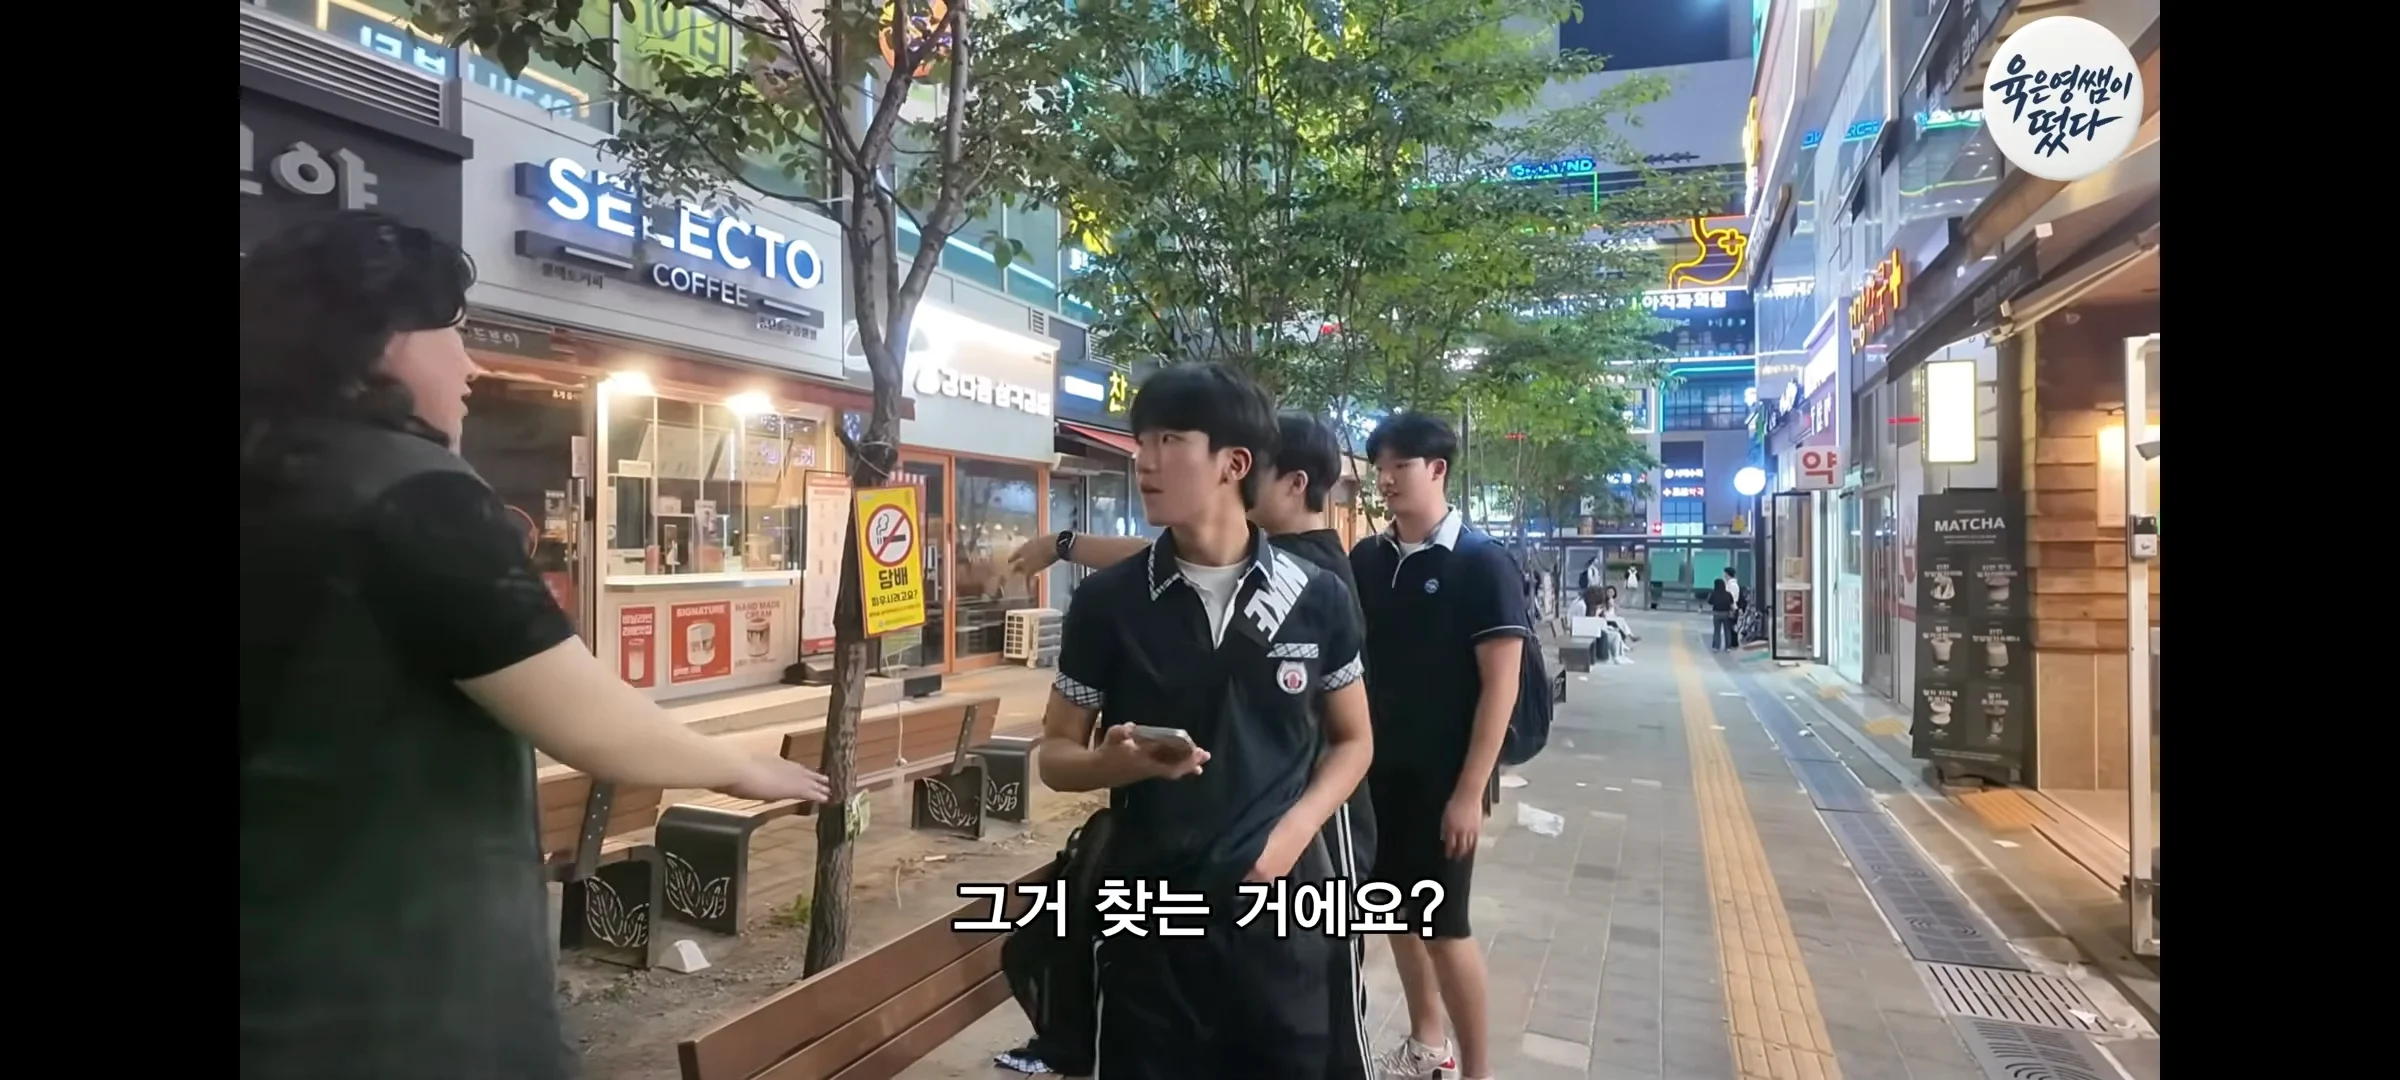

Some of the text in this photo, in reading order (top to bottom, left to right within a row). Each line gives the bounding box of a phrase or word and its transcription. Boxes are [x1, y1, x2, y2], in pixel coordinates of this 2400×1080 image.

[652, 262, 749, 308] COFFEE
[1801, 450, 1838, 485] 약
[1933, 516, 2006, 533] MATCHA
[878, 566, 909, 590] 담배
[735, 600, 781, 612] HAND MADE
[871, 589, 918, 607] 피우시려고요?
[1243, 552, 1310, 643] NIKE
[676, 605, 726, 618] SIGNATURE
[745, 610, 772, 620] CREAM
